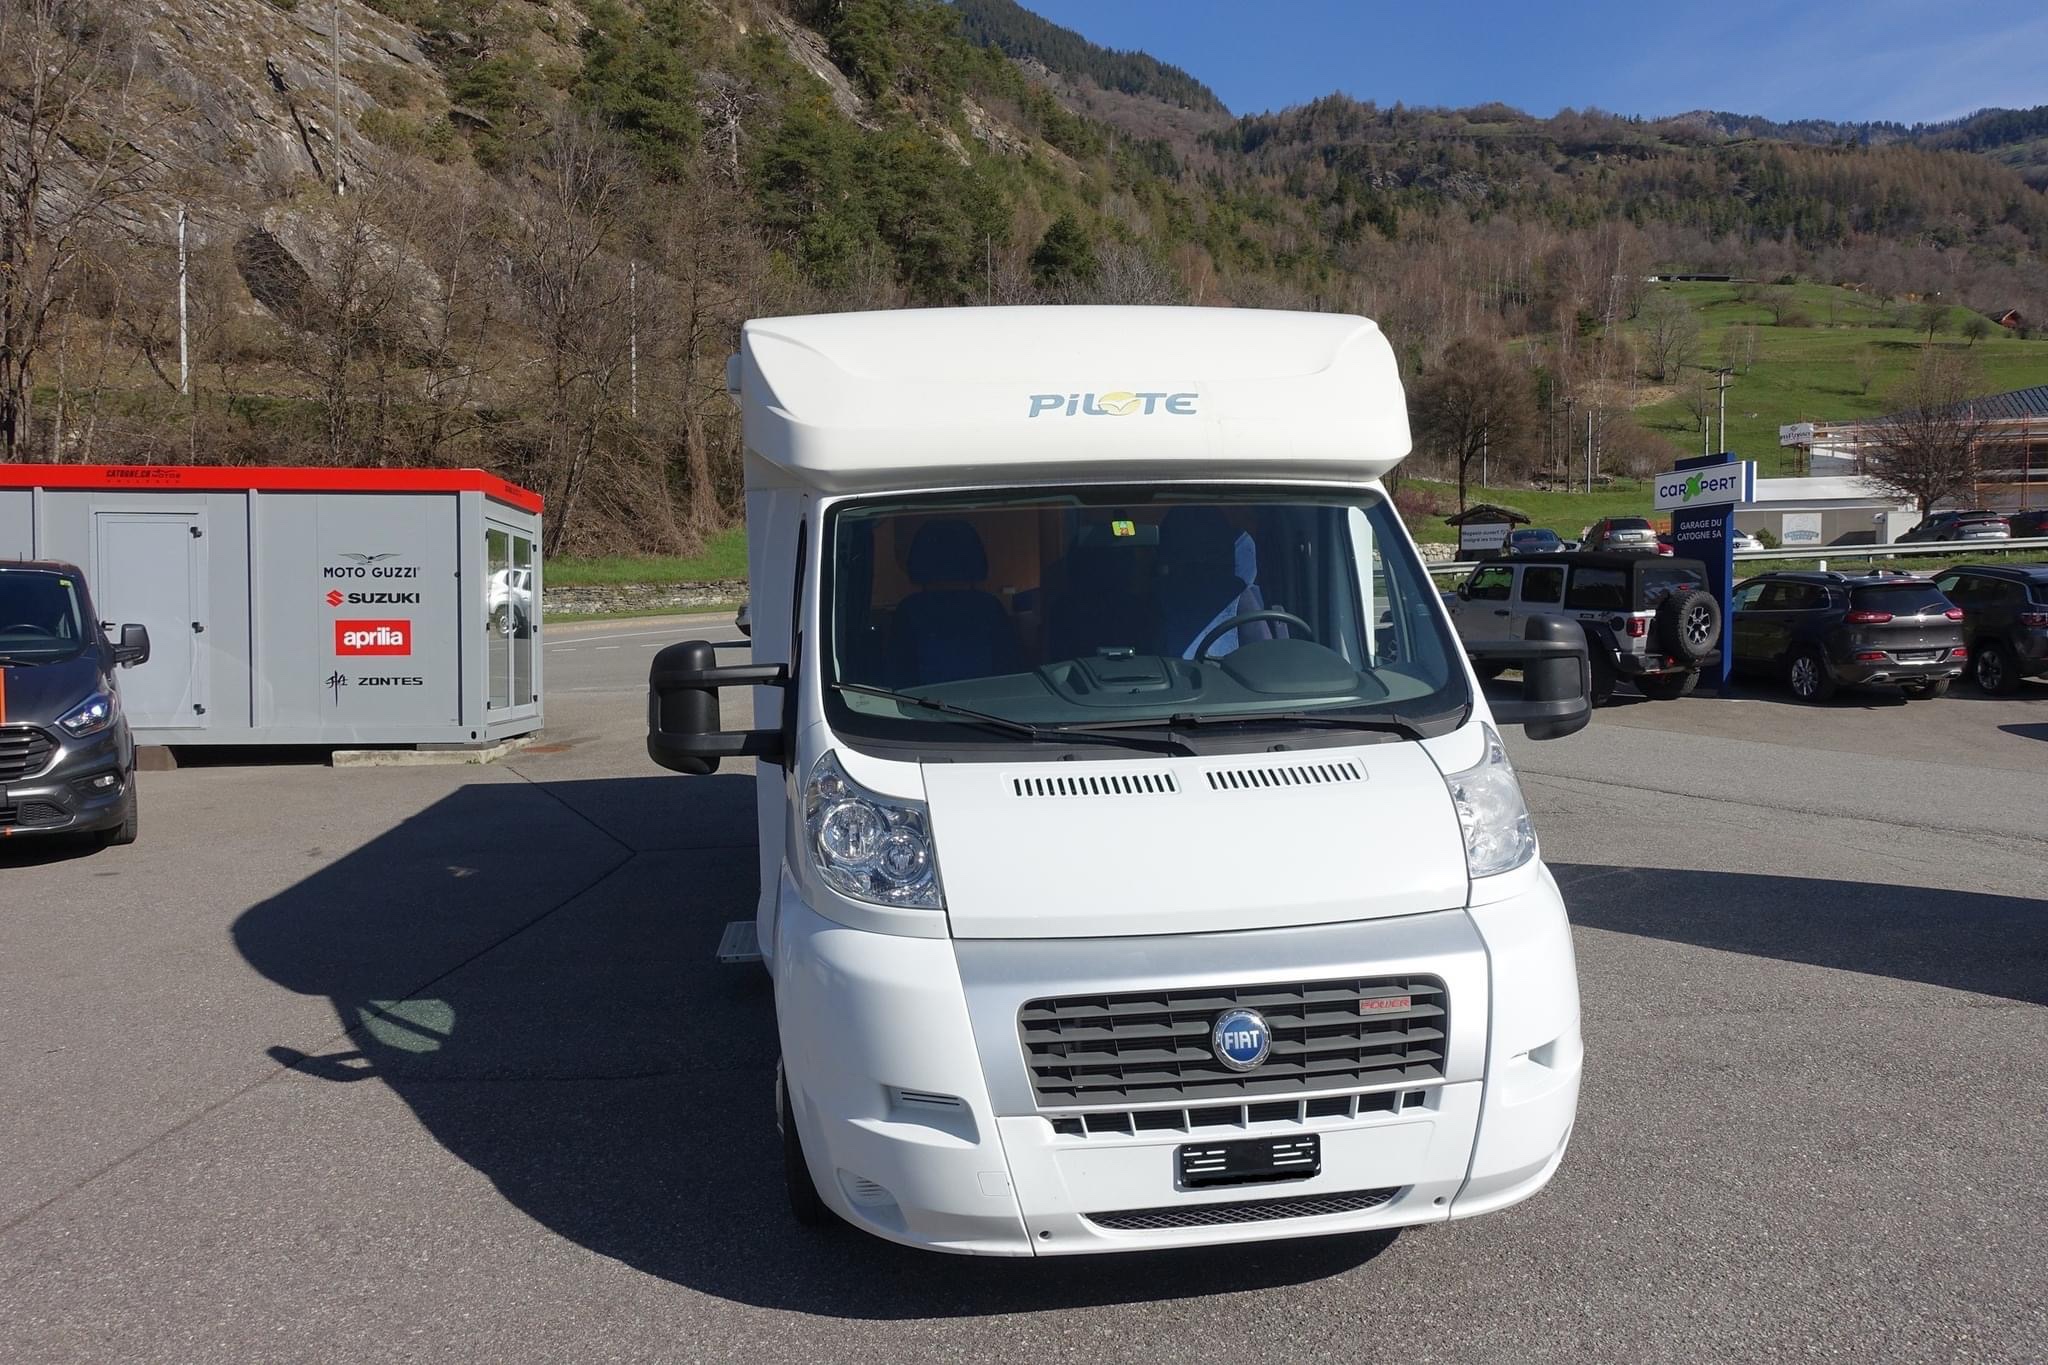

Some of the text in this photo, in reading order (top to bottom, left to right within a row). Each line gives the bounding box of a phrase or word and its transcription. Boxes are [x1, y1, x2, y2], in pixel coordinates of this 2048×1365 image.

[1680, 518, 1722, 530] GARAGE DU
[1677, 530, 1722, 541] CATOGNE SA
[323, 567, 417, 578] MOTO GUZZI
[347, 592, 420, 604] SUZUKI
[343, 626, 403, 649] aprilia
[358, 677, 424, 686] ZONTES
[1360, 998, 1410, 1010] POWER
[1224, 1029, 1260, 1050] FIAT
